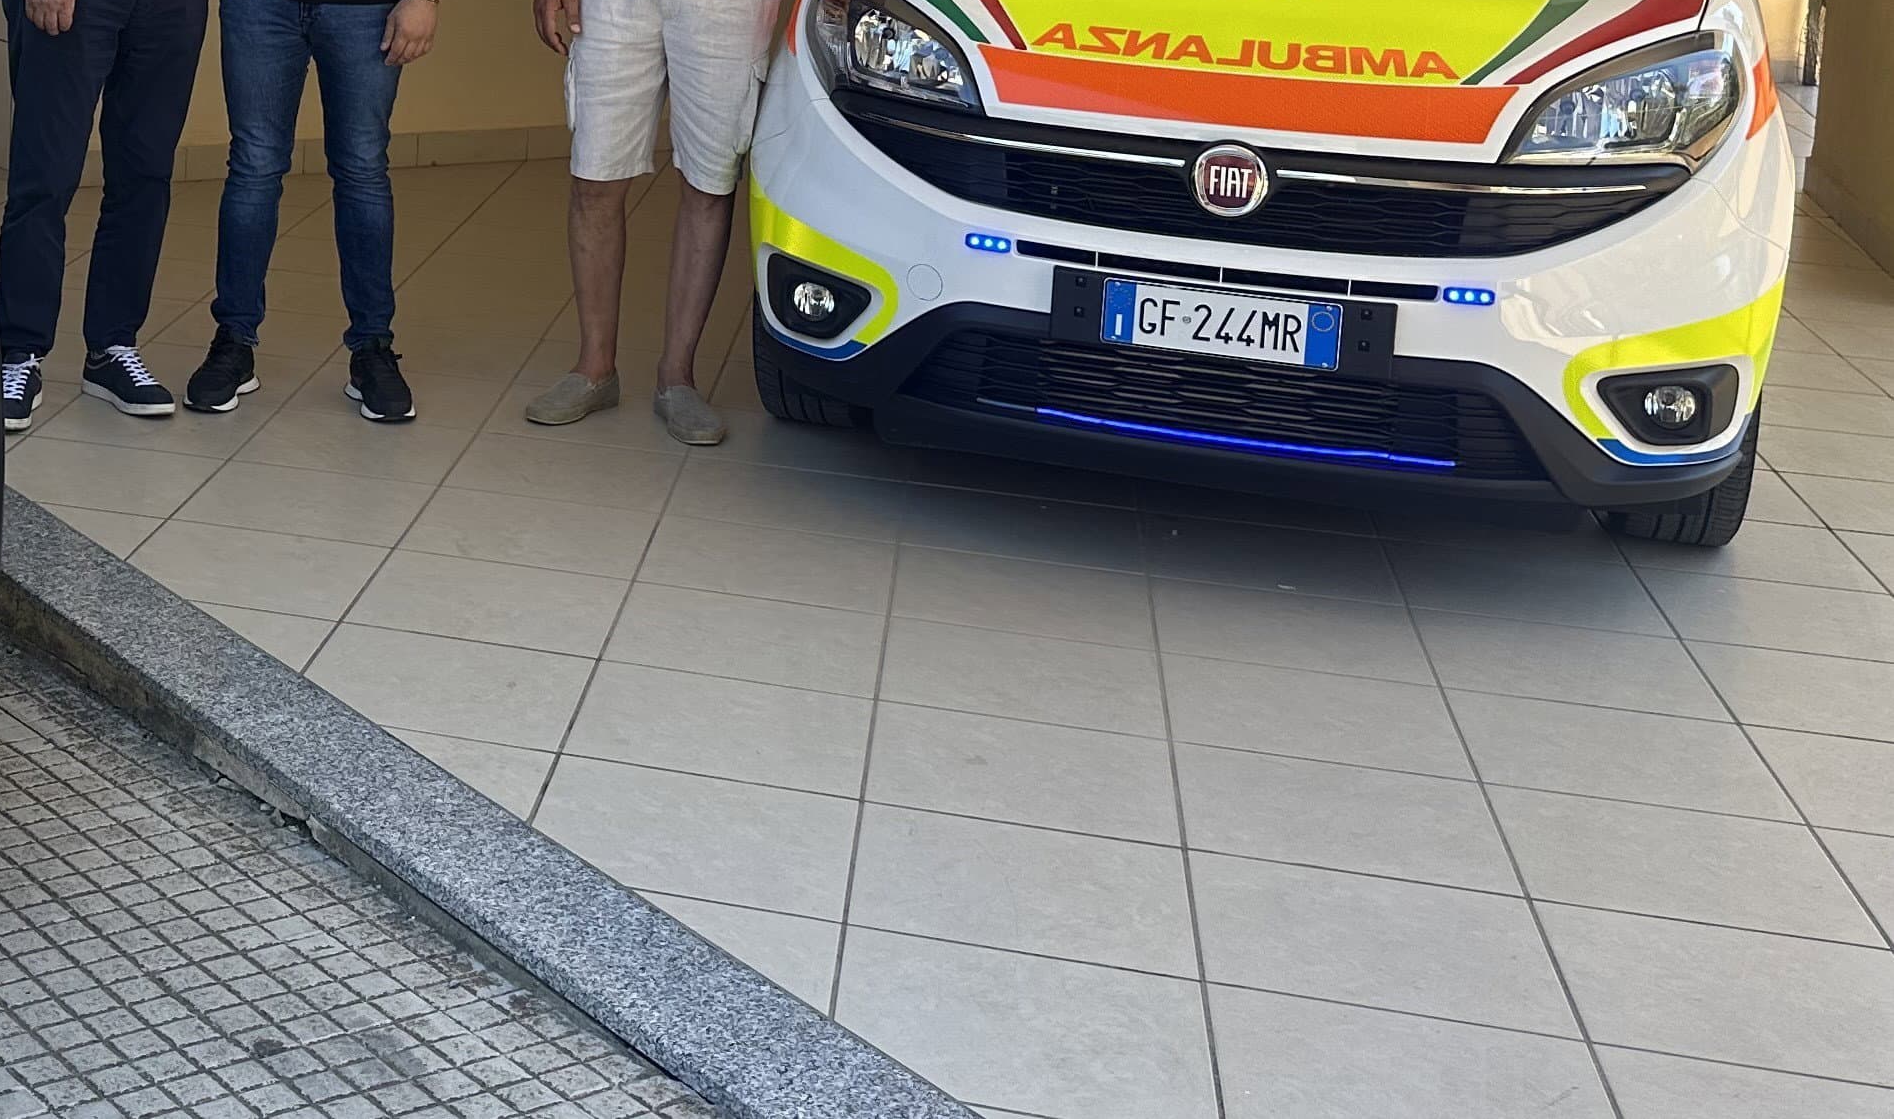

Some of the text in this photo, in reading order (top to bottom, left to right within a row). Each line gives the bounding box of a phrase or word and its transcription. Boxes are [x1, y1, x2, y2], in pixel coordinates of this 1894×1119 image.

[1209, 165, 1253, 199] FIAT
[1138, 297, 1181, 336] GF
[1192, 304, 1302, 353] 244MR
